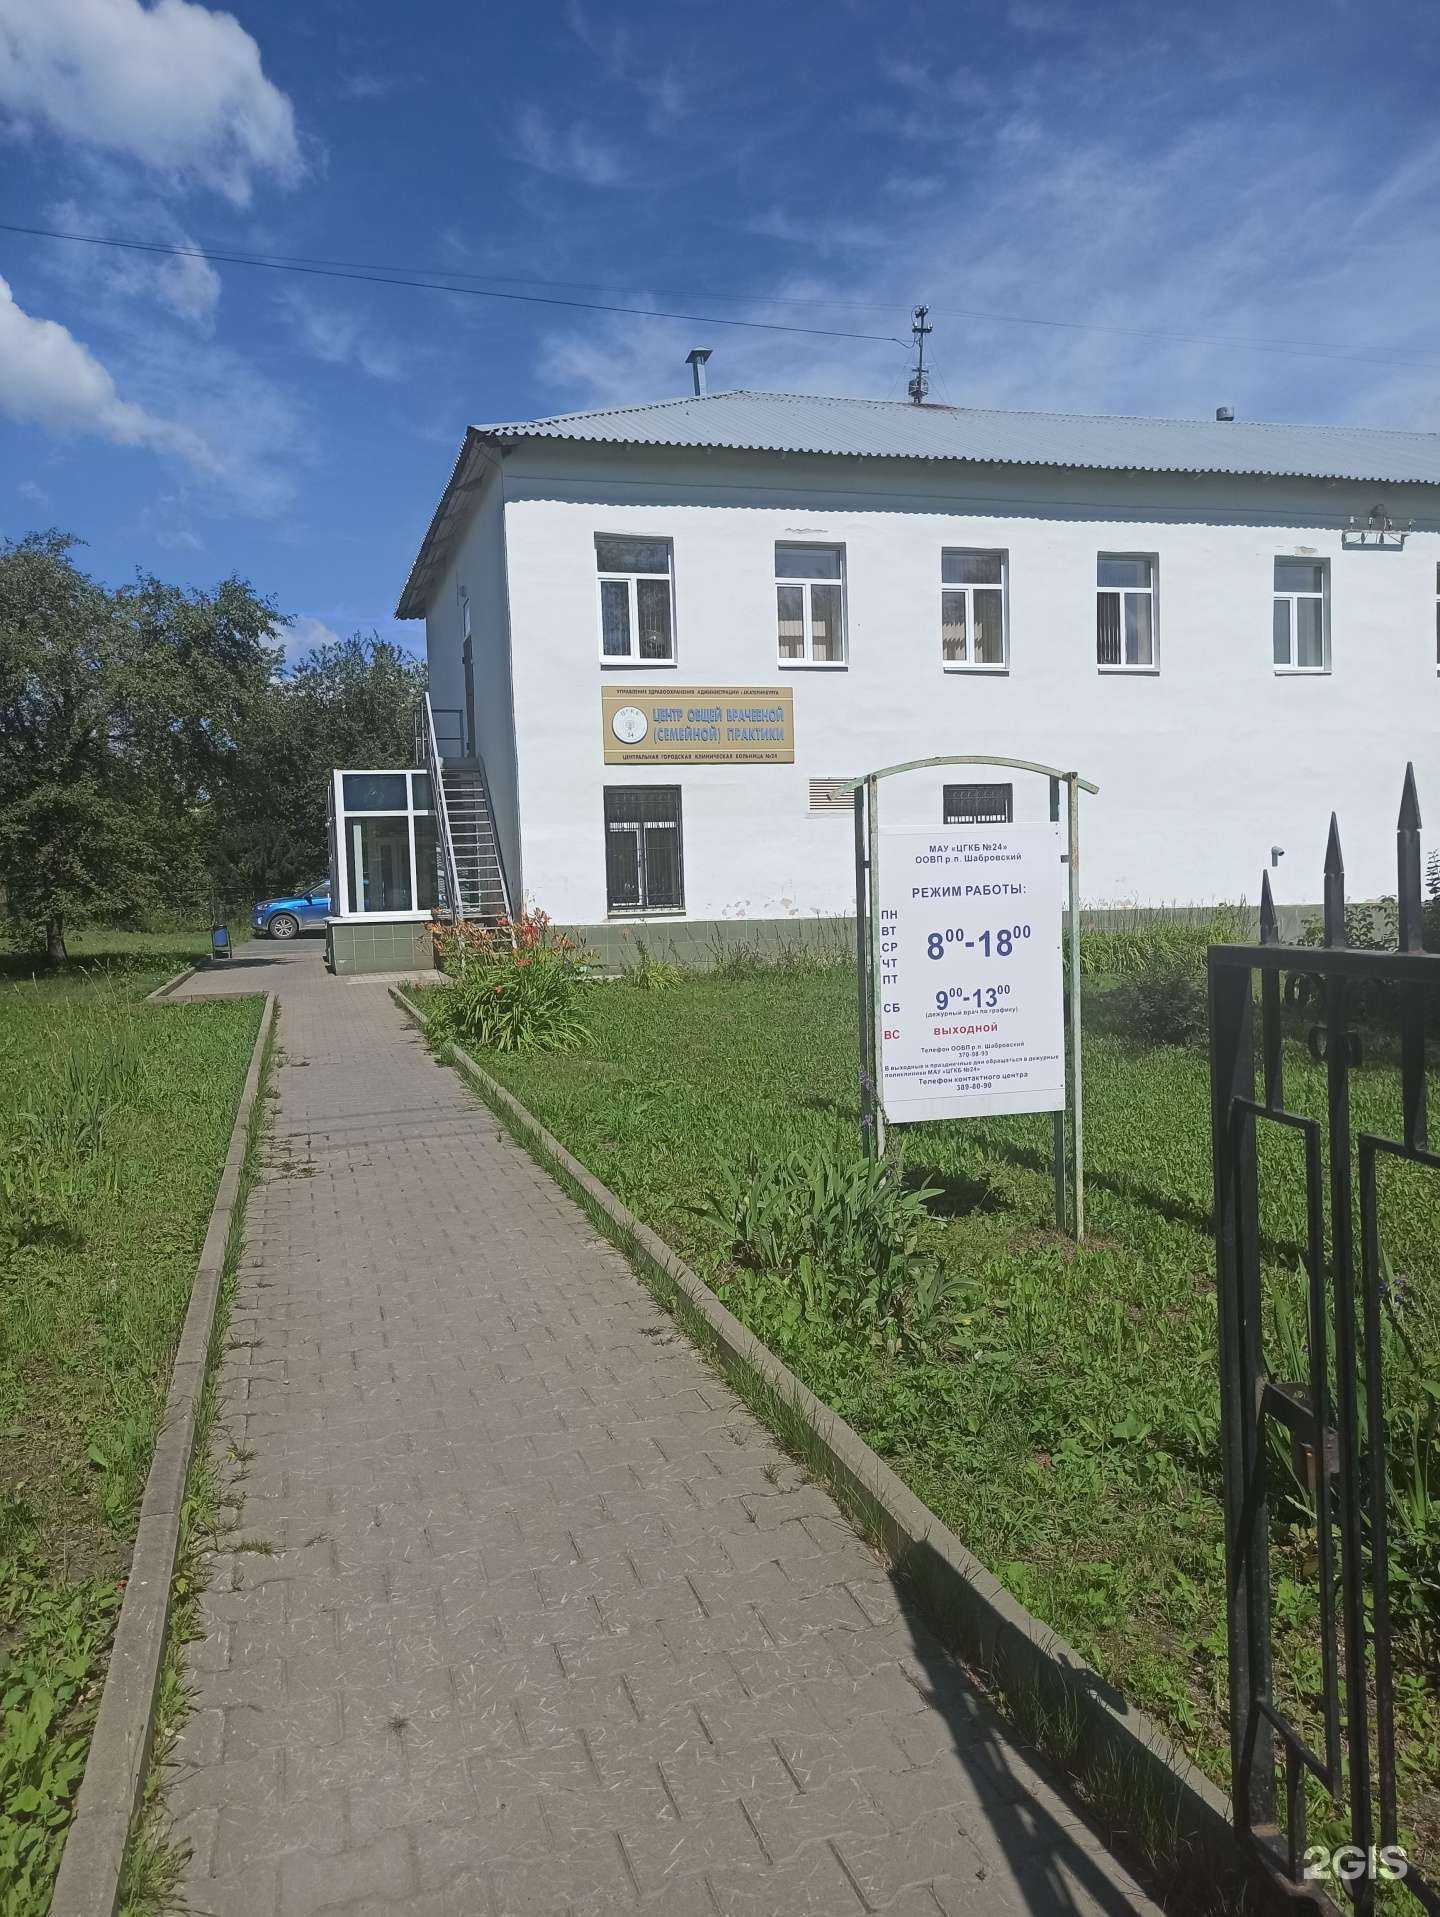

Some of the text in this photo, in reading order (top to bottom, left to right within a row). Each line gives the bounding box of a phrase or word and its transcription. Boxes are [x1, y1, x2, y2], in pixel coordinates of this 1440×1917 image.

[653, 706, 784, 723] ЦЕНТР ОБЩЕЙ ВРАЧЕБНОЙ
[653, 726, 784, 744] (СЕМЕЙНОЙ) ПРАКТИКИ
[951, 844, 980, 853] «ЦГКБ
[982, 842, 1008, 851] №24»
[964, 852, 1022, 862] Шабровский
[912, 883, 1027, 898] РЕЖИМ РАБОТЫ:
[881, 910, 898, 919] ПН
[881, 926, 897, 936] ВТ
[881, 942, 898, 952] СР
[882, 958, 898, 968] ЧТ
[882, 974, 898, 984] ПТ
[883, 1003, 900, 1013] СБ
[884, 1030, 900, 1040] ВС
[984, 1041, 1025, 1049] Шабровский
[918, 1071, 1029, 1086] Телефон контактного центра
